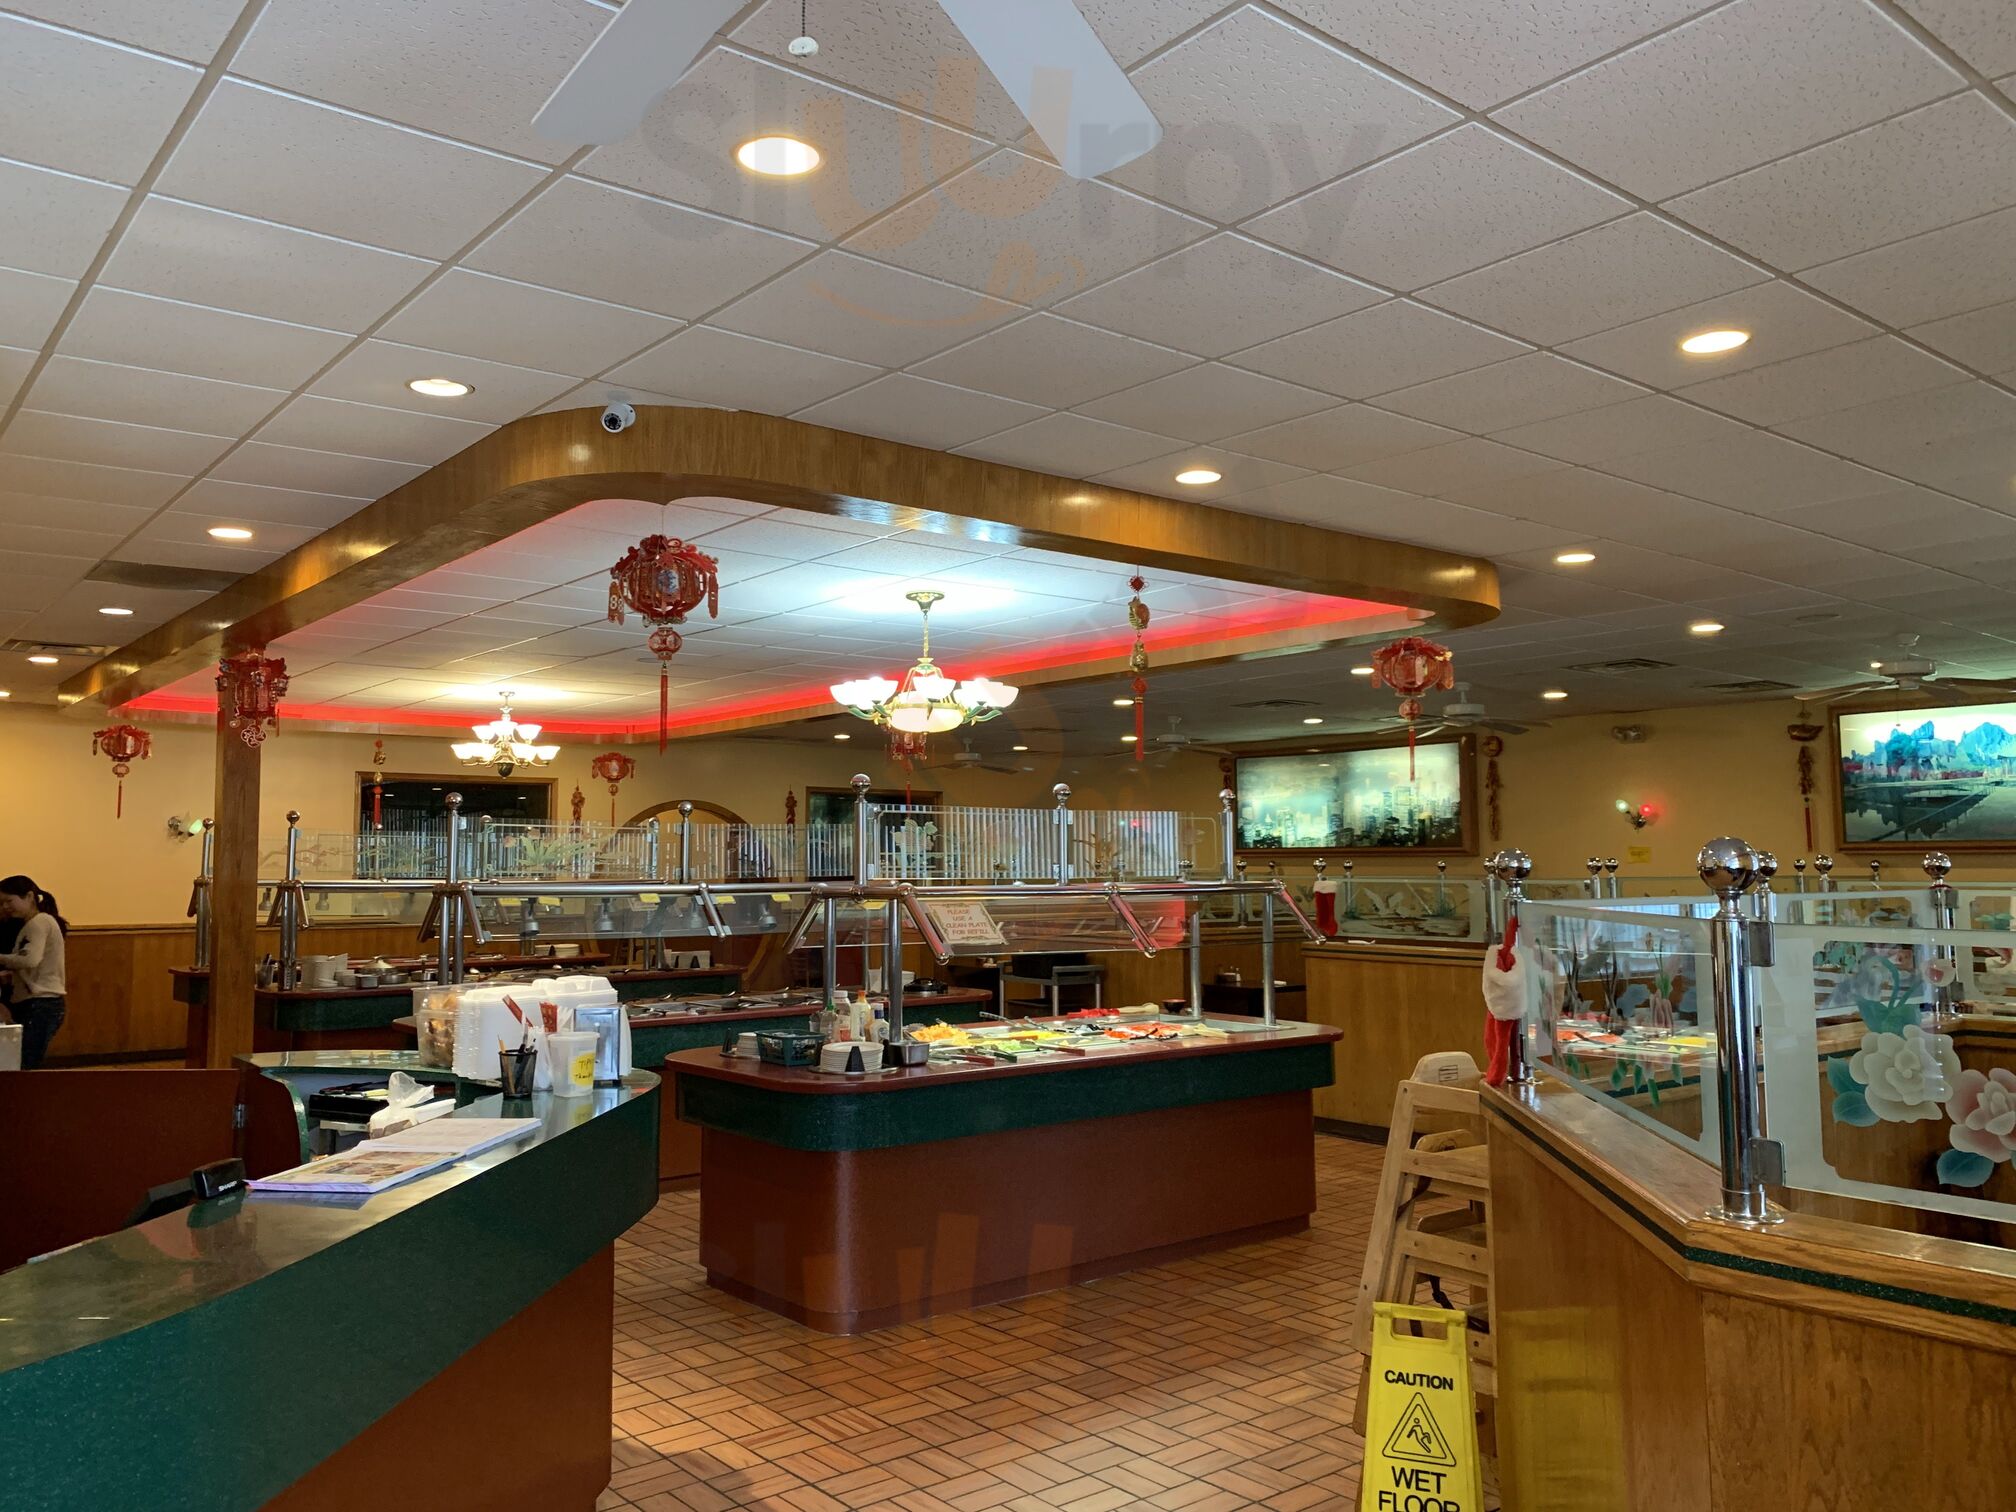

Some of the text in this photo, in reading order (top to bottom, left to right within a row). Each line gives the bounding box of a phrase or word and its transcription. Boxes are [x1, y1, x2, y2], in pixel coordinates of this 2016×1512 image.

[218, 1180, 237, 1191] SHARP
[1384, 1370, 1454, 1391] CAUTION
[1391, 1466, 1447, 1494] WET
